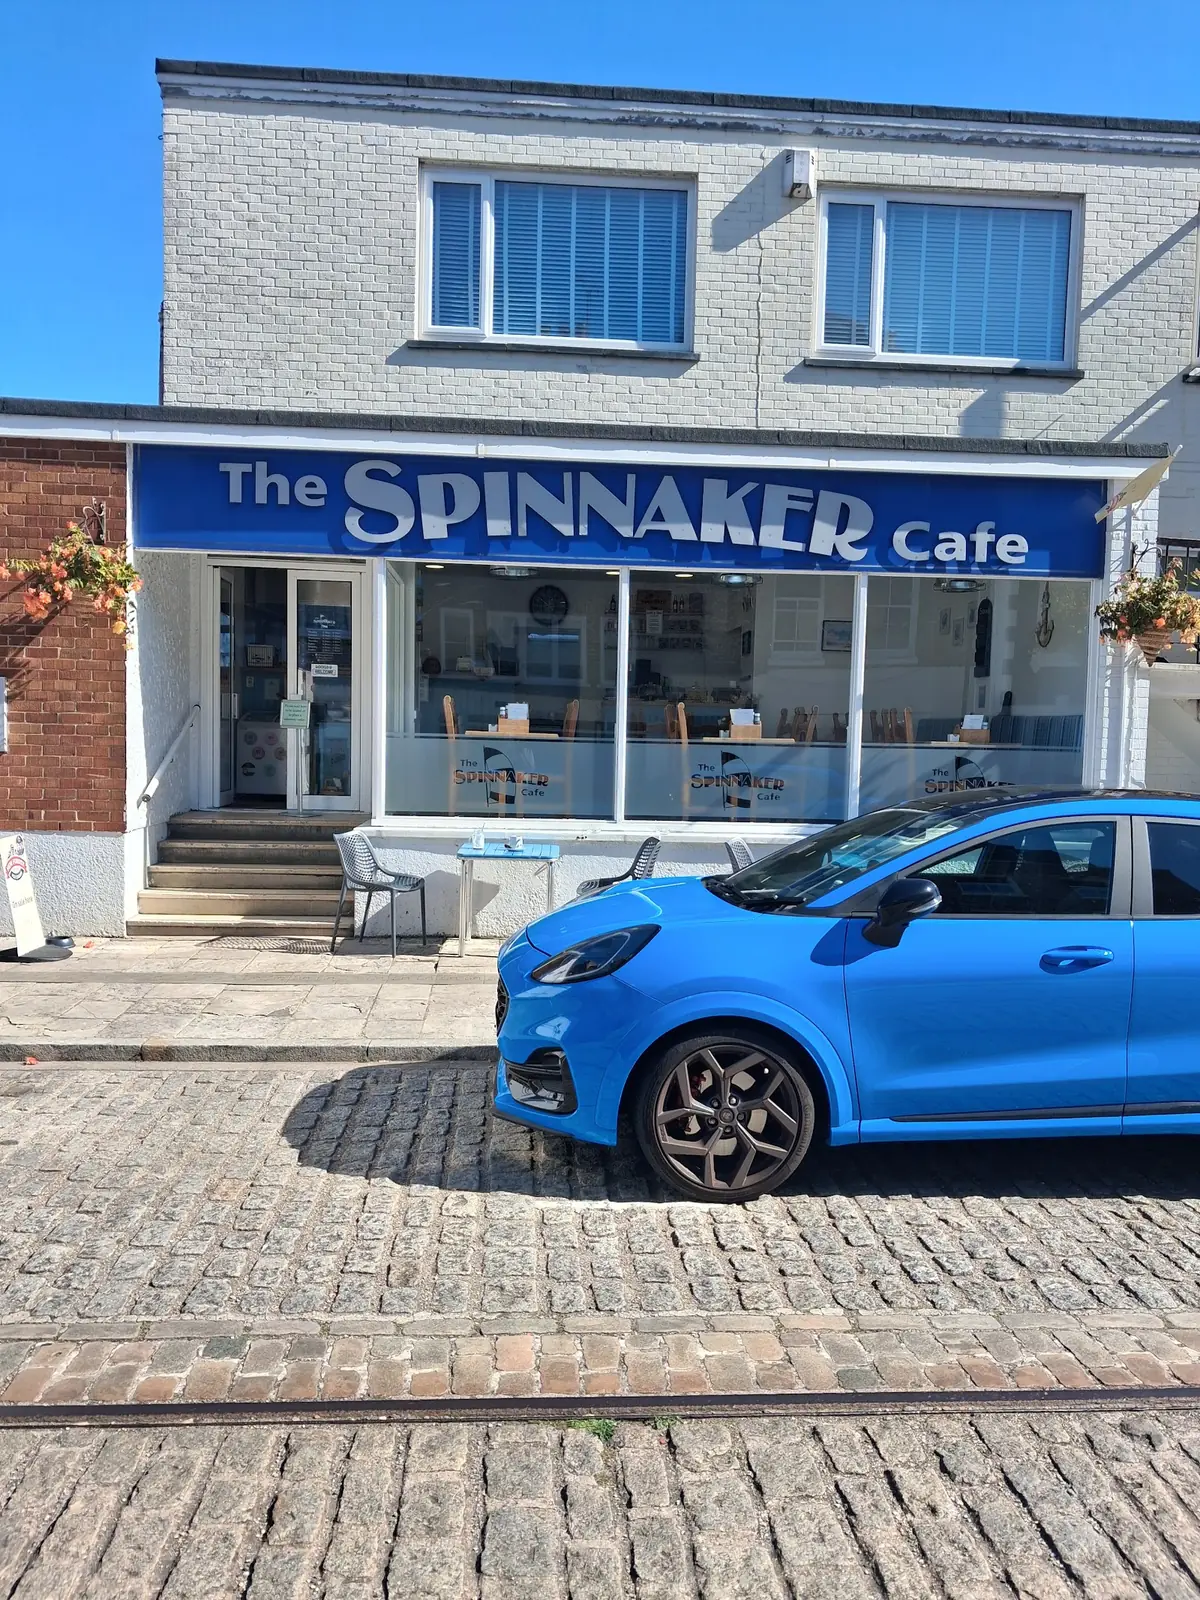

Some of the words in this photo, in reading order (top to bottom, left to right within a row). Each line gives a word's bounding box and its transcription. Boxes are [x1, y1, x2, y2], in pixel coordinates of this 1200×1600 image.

[218, 460, 328, 507] The
[343, 459, 875, 562] SPINNAKER
[892, 520, 1030, 564] Cafe
[460, 759, 478, 767] The
[698, 763, 715, 772] The
[932, 768, 949, 777] The
[454, 769, 549, 787] SPINNAKER
[691, 773, 785, 791] SPINNAKER
[924, 778, 1017, 794] SPINNA
[521, 788, 545, 797] Cafe
[757, 792, 780, 801] Cafe
